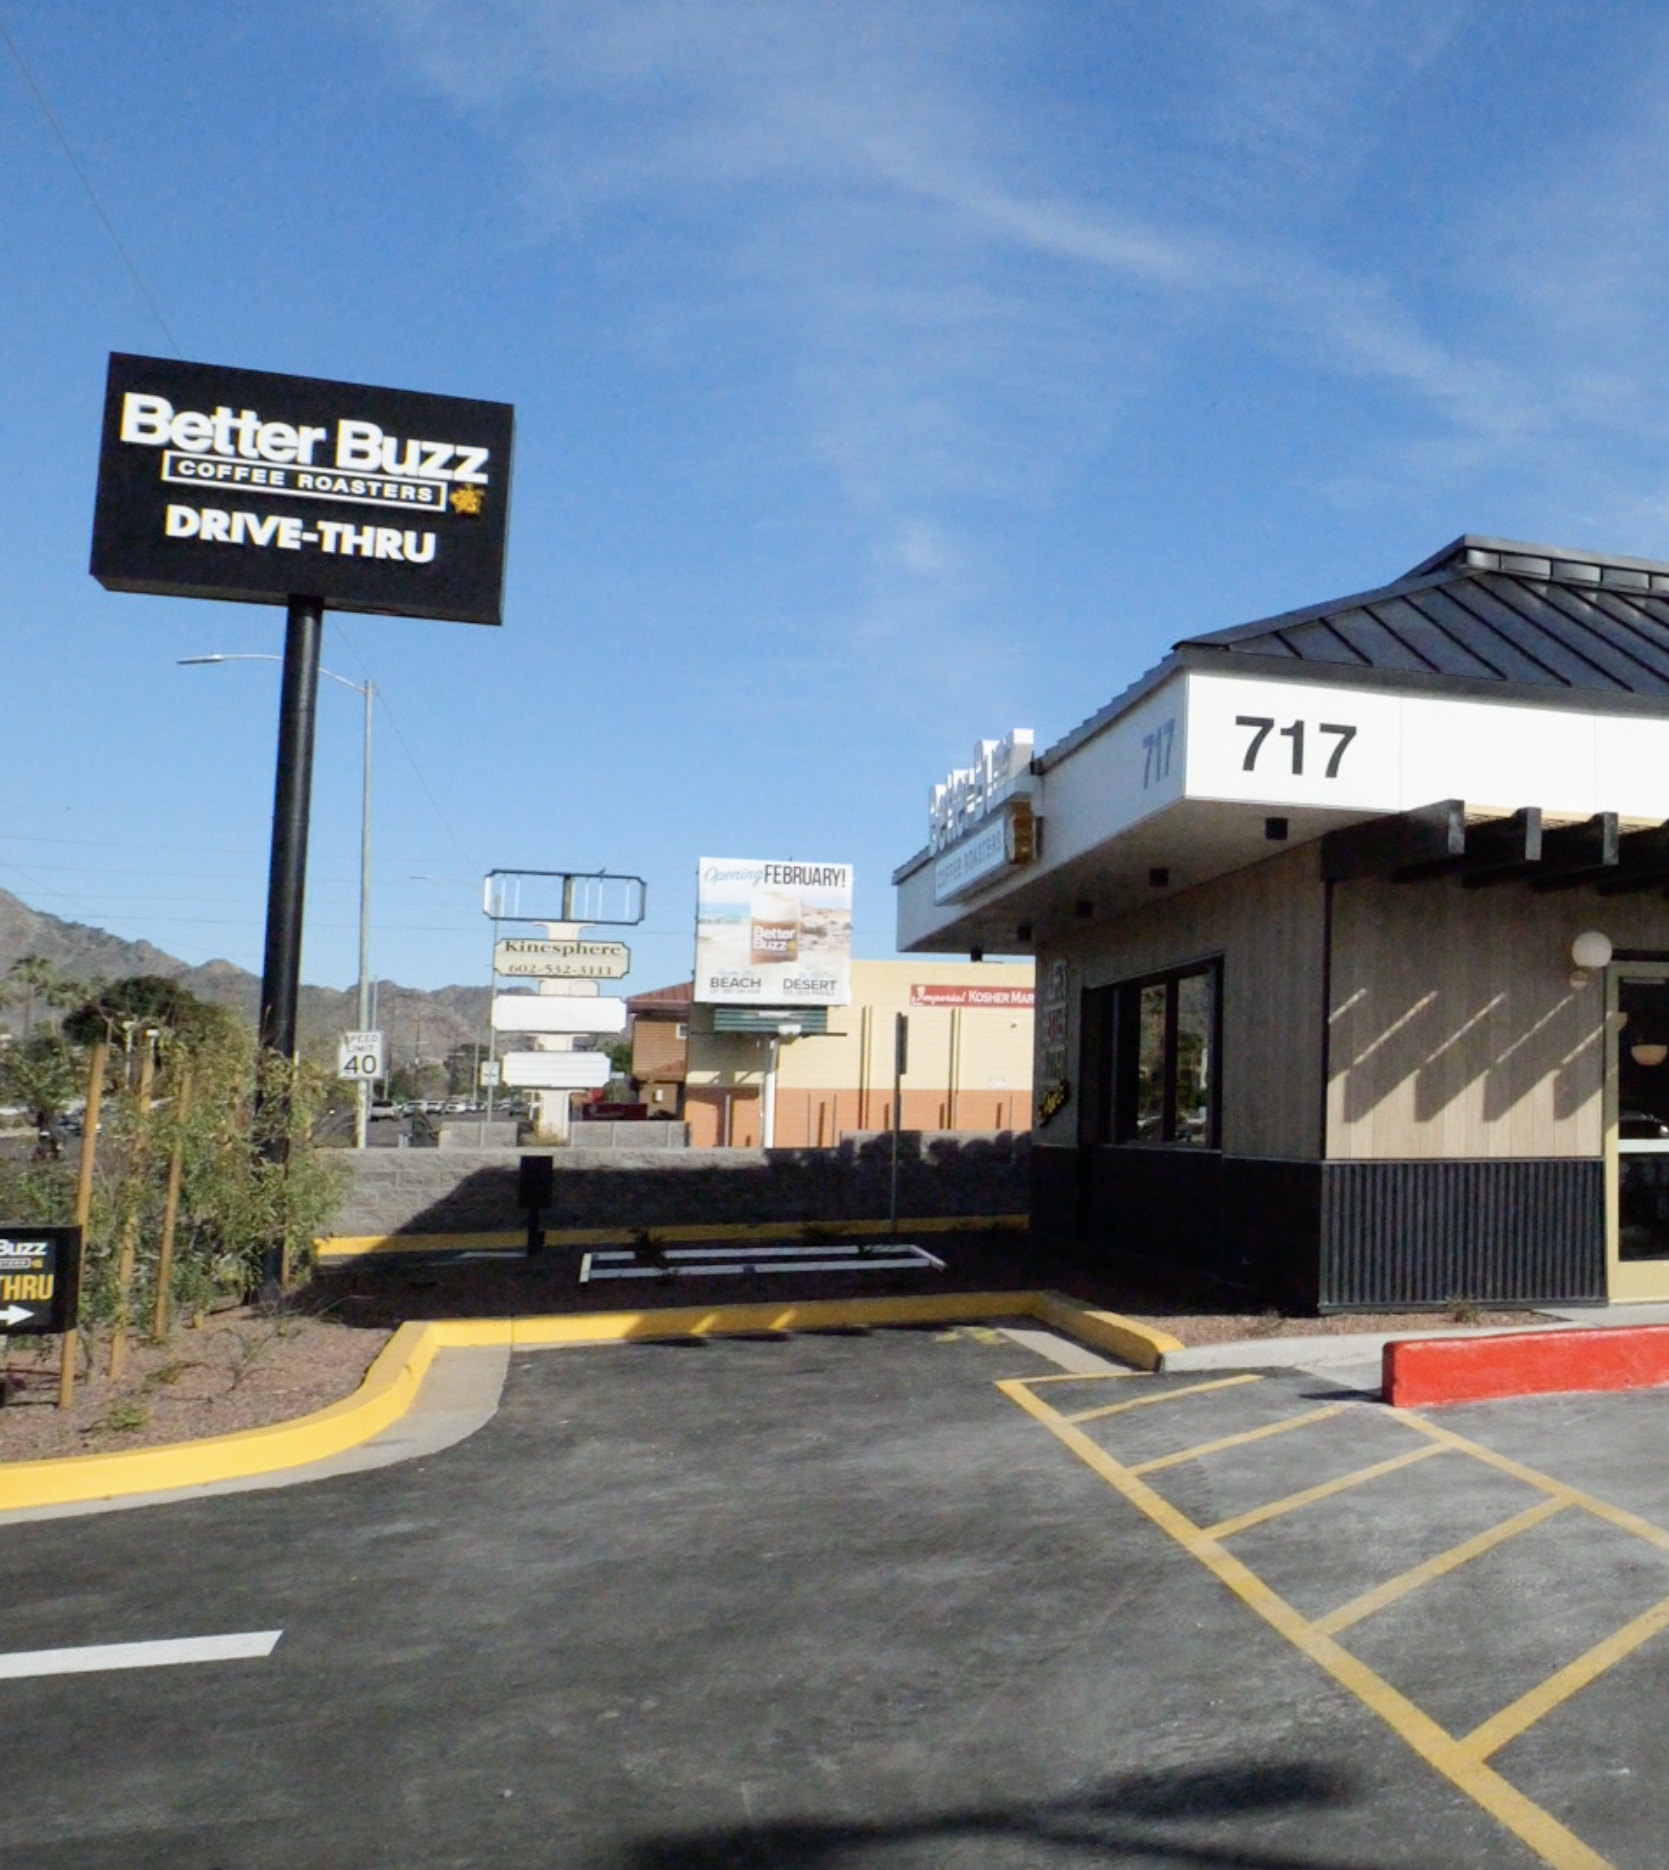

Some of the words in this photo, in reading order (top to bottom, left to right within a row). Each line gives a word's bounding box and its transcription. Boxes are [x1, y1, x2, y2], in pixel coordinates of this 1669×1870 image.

[120, 391, 327, 466] Better
[335, 418, 489, 484] Buzz
[177, 459, 286, 486] COFFEE
[297, 473, 433, 502] ROASTERS
[165, 504, 436, 563] DRIVE-THRU
[1142, 718, 1175, 790] 717
[1235, 715, 1357, 778] 717
[704, 867, 764, 886] Opening
[764, 864, 846, 888] FEBRUARY!
[753, 925, 796, 939] Better
[505, 941, 621, 957] Kinesphere
[753, 938, 787, 951] Buzz
[710, 977, 761, 988] BEACH
[783, 979, 837, 991] DESERT
[344, 1034, 378, 1043] PEED
[344, 1055, 377, 1074] 40
